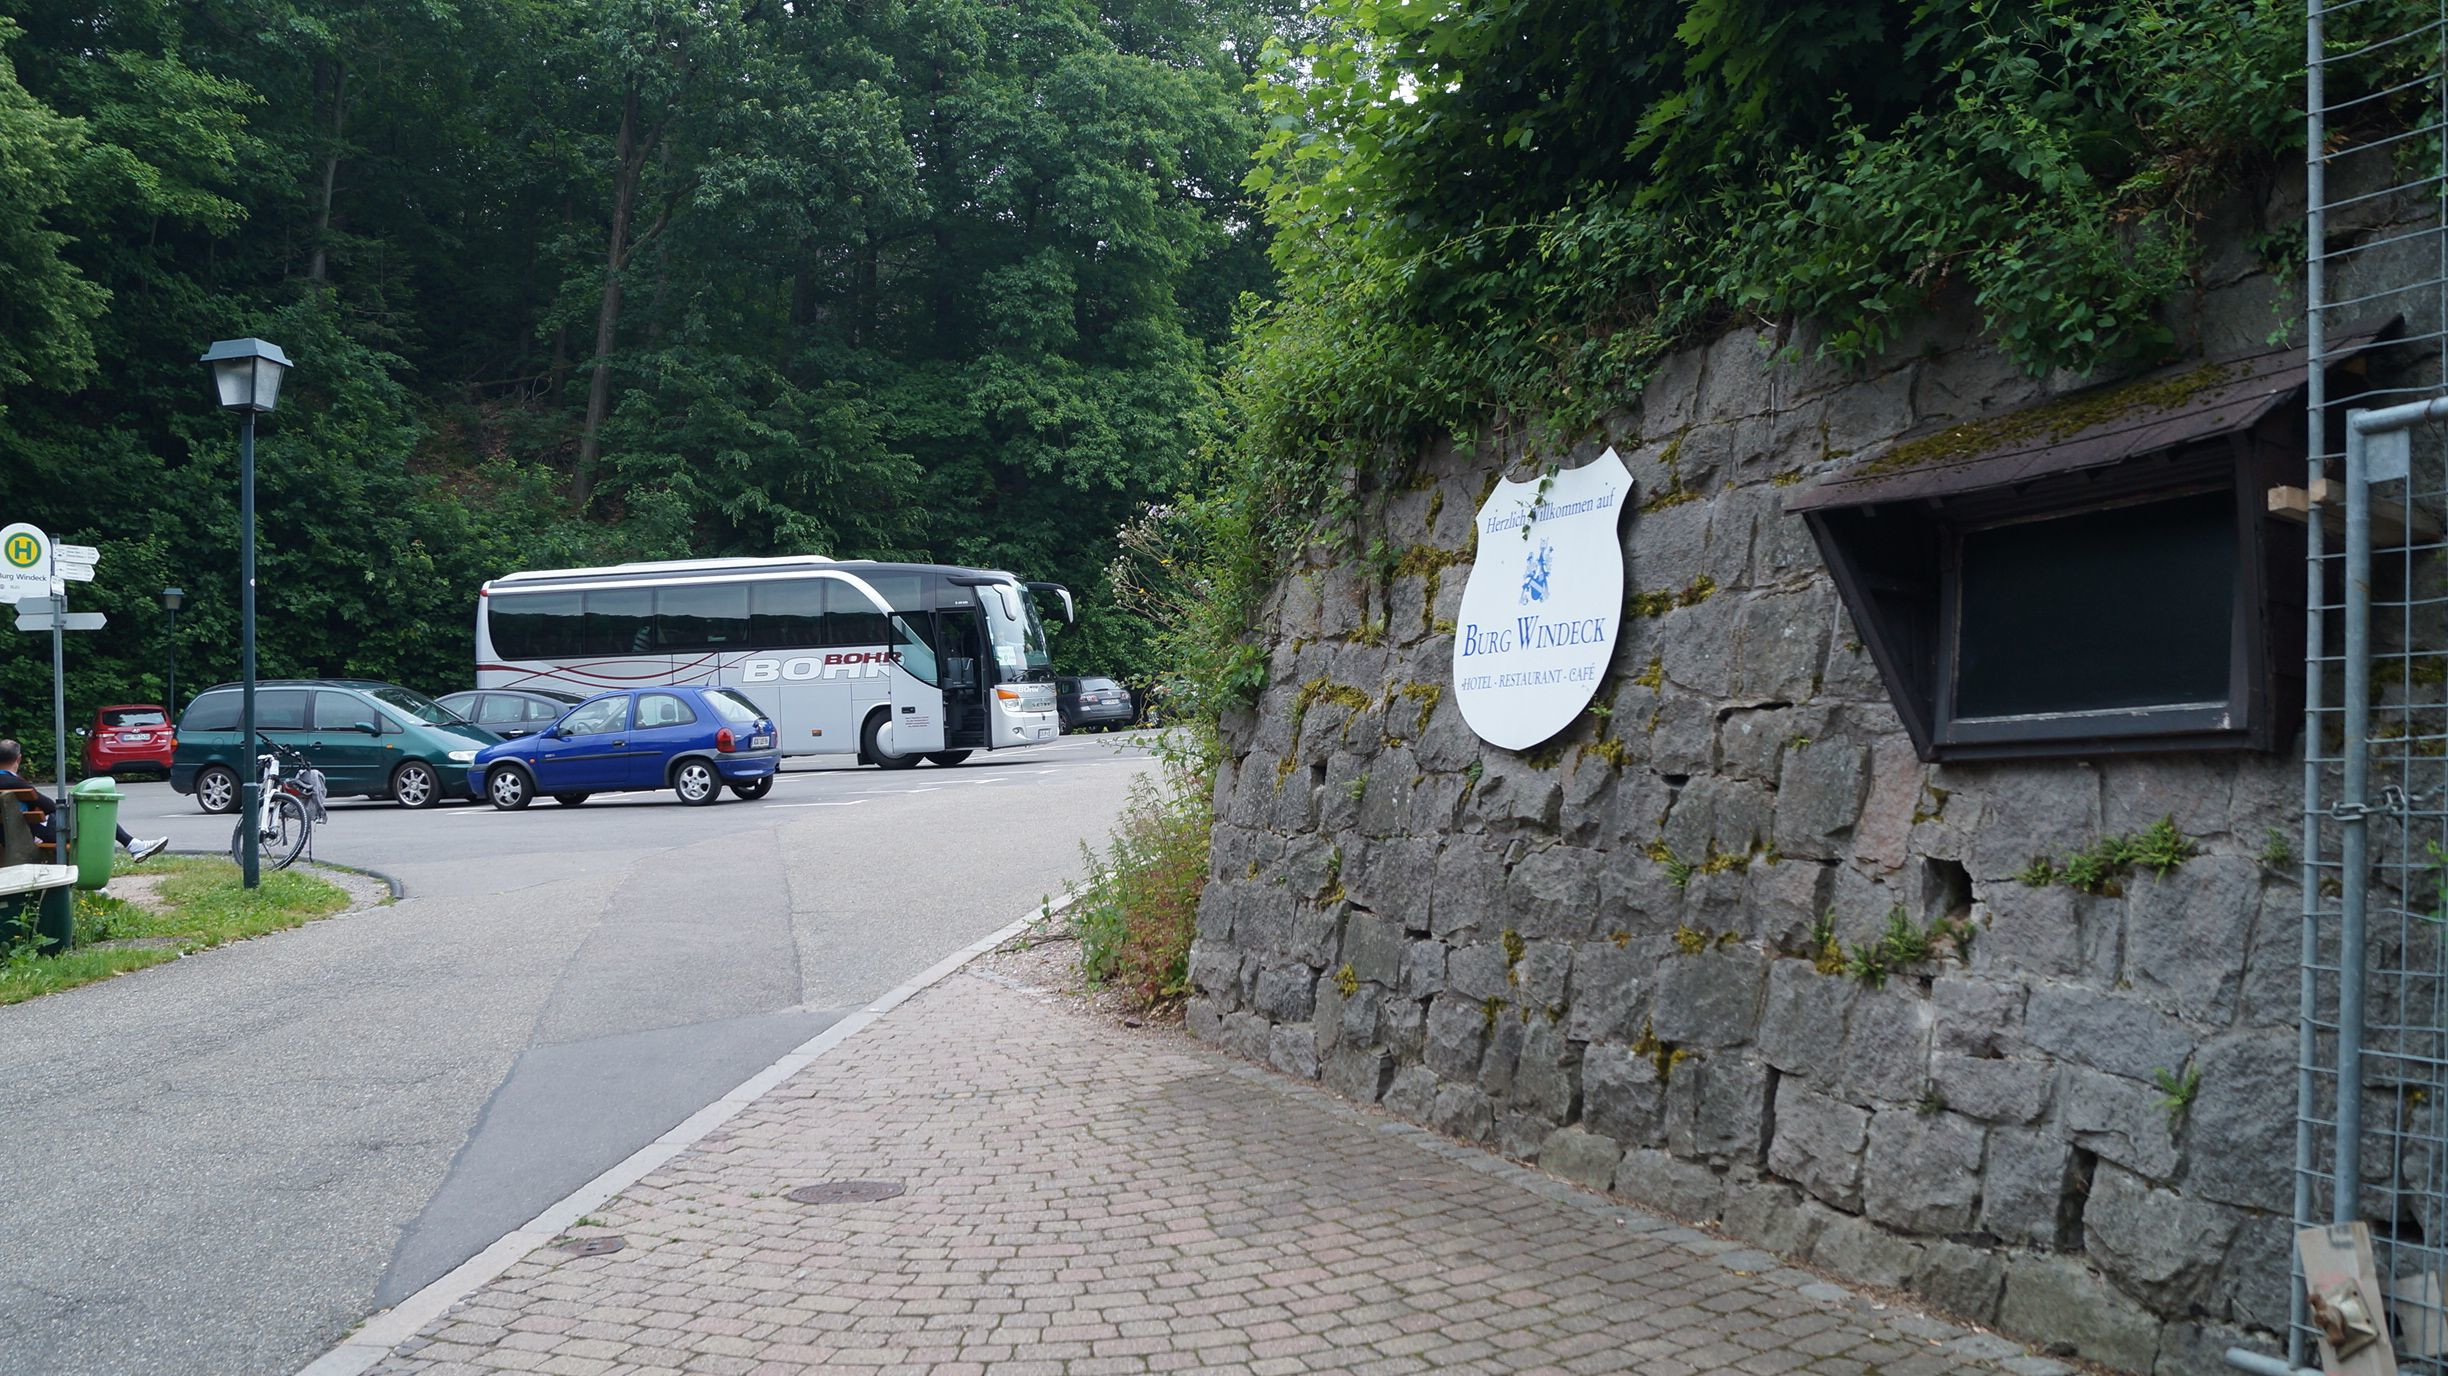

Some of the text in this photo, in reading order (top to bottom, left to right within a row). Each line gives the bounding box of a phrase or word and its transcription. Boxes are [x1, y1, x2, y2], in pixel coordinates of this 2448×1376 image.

[1486, 509, 1526, 534] Herzlich
[1597, 487, 1616, 509] auf
[15, 541, 31, 560] H
[16, 574, 47, 582] Windeck
[1462, 615, 1606, 656] BURG WINDECK
[824, 651, 902, 665] BOHR
[1462, 675, 1492, 691] HOTEL
[1499, 669, 1563, 687] RESTAURANT
[1569, 662, 1595, 681] CAFÉ
